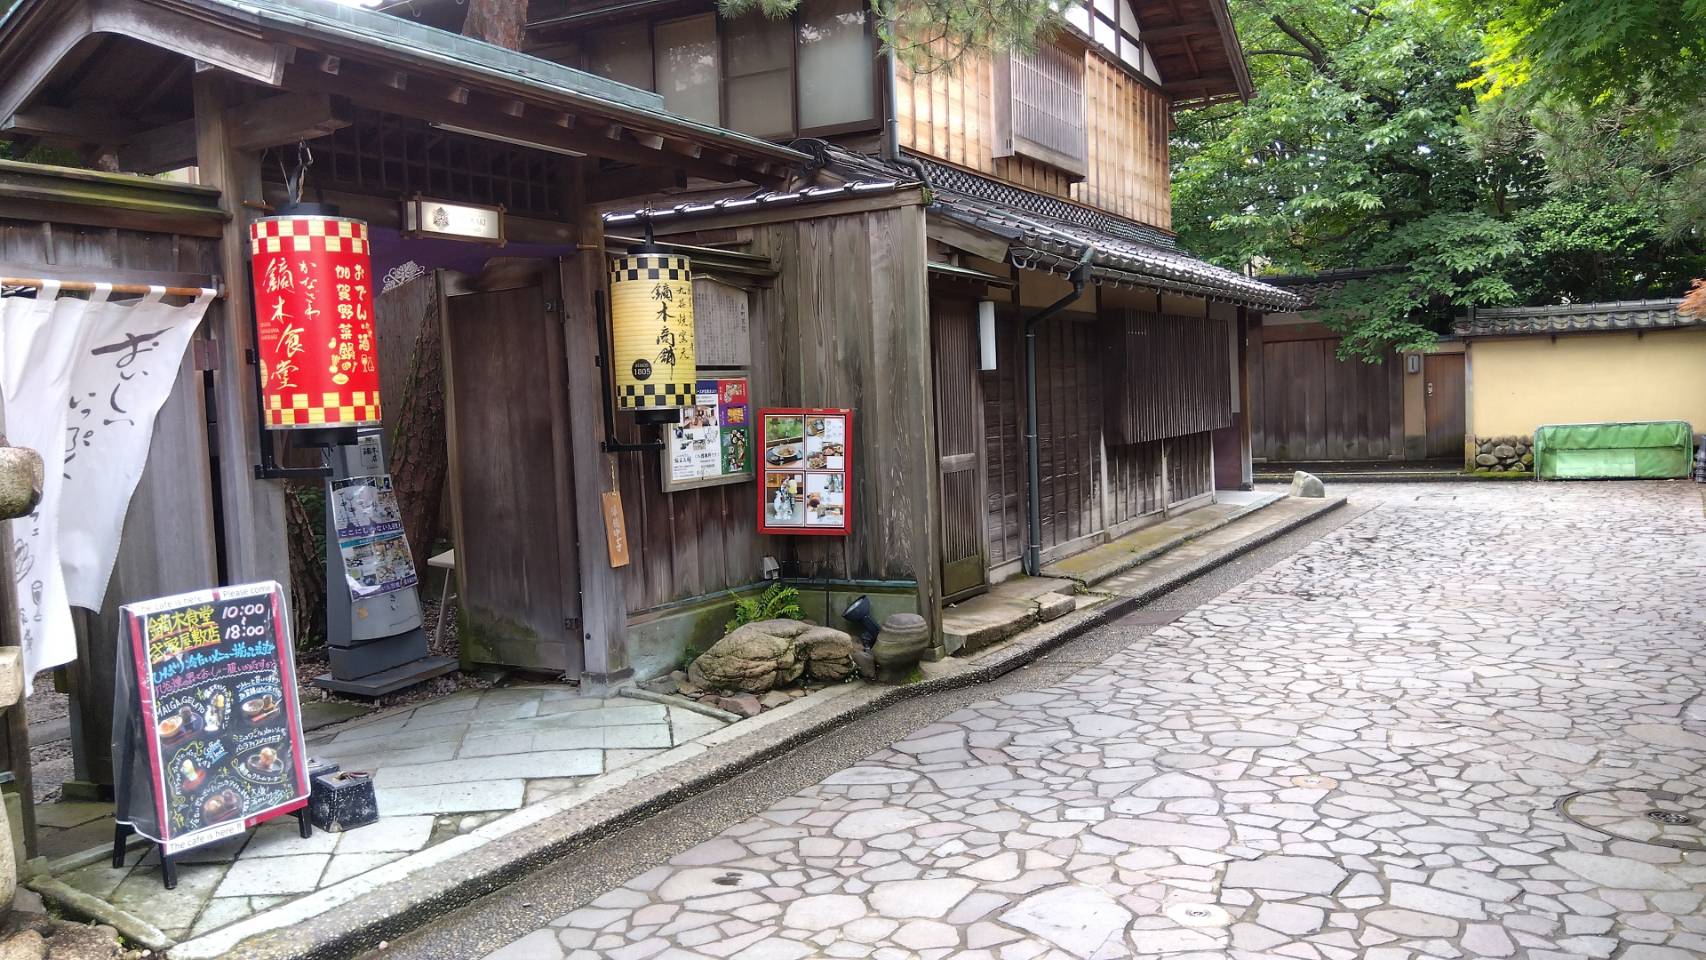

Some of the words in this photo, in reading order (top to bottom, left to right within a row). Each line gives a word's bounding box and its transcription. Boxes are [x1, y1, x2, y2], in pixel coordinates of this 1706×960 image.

[299, 260, 320, 320] かなざわ
[262, 257, 305, 390] 鏑木食堂
[335, 264, 356, 360] 加賀野菜鍋
[223, 588, 248, 598] Please
[149, 605, 216, 639] 鏑木食堂
[222, 603, 265, 619] 10:00
[225, 625, 265, 639] 18:00
[187, 836, 205, 846] cafe
[215, 828, 234, 838] here
